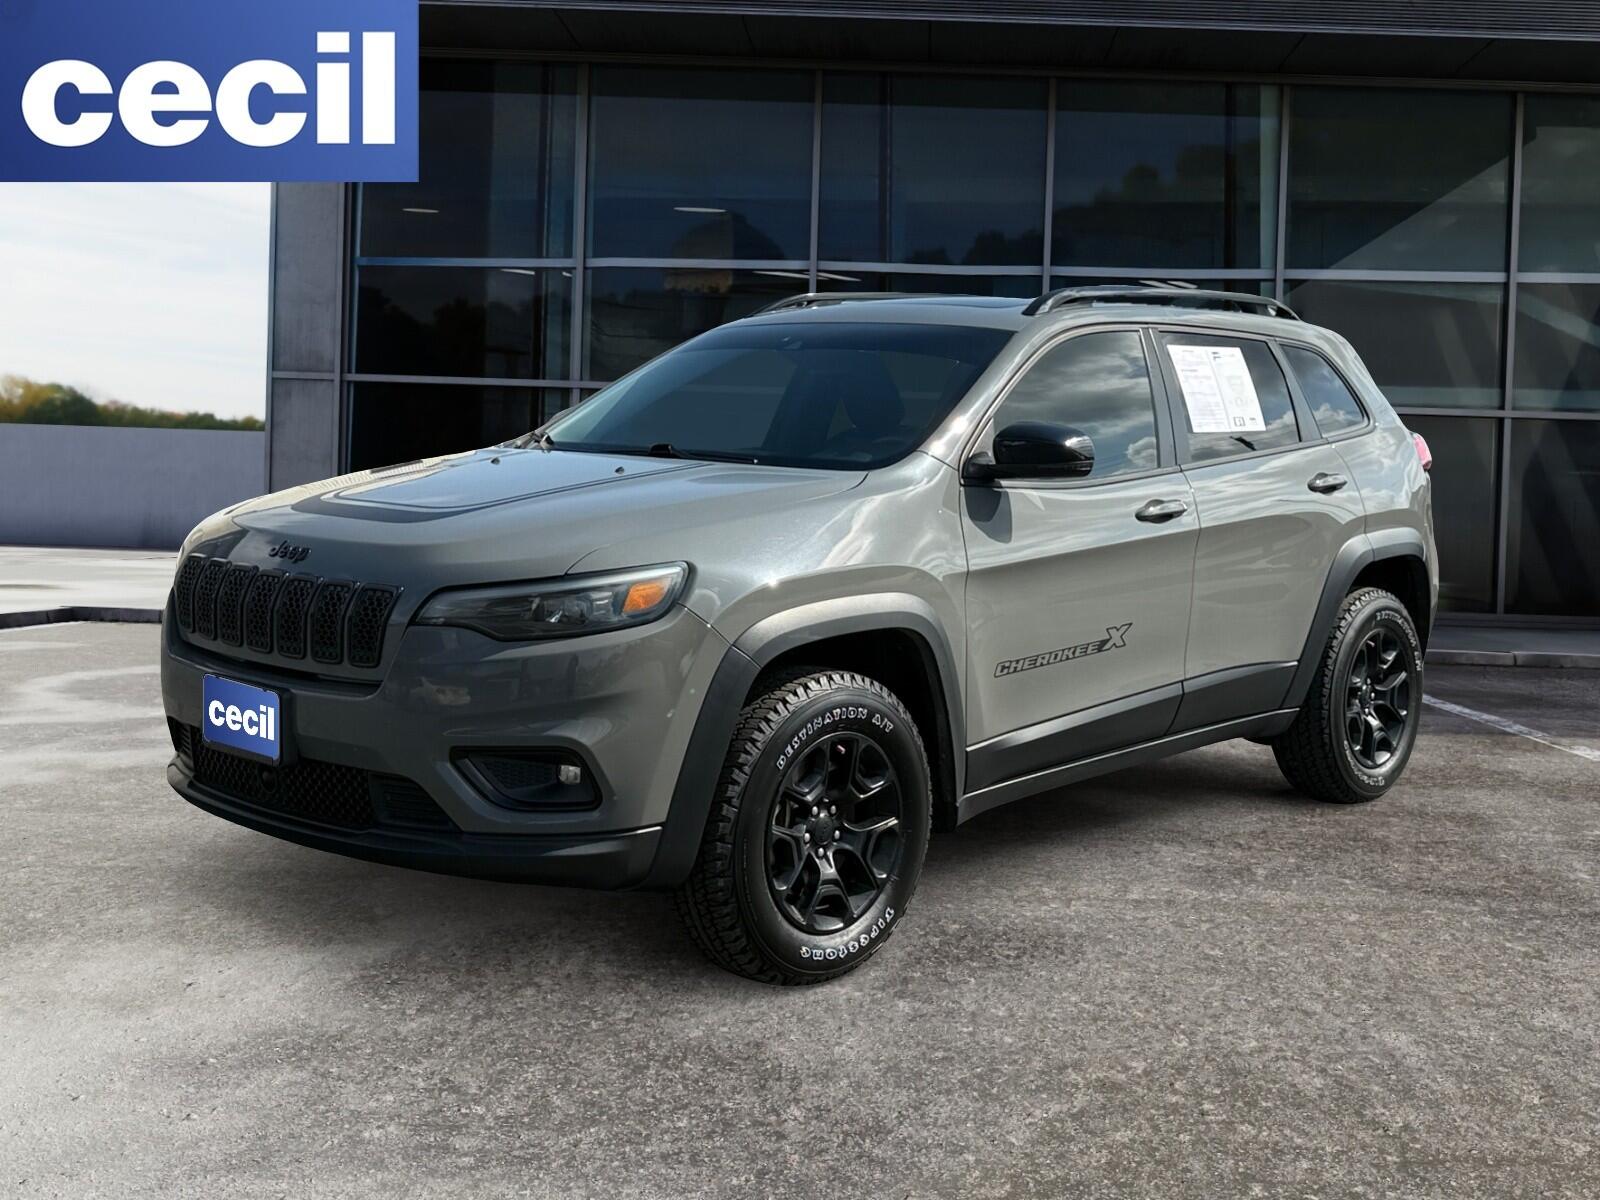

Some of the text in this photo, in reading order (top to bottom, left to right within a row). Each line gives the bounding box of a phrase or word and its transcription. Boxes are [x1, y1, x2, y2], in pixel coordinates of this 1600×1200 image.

[268, 540, 312, 563] Jeep
[208, 699, 275, 741] cecil
[776, 706, 894, 770] DESTINATION A/T
